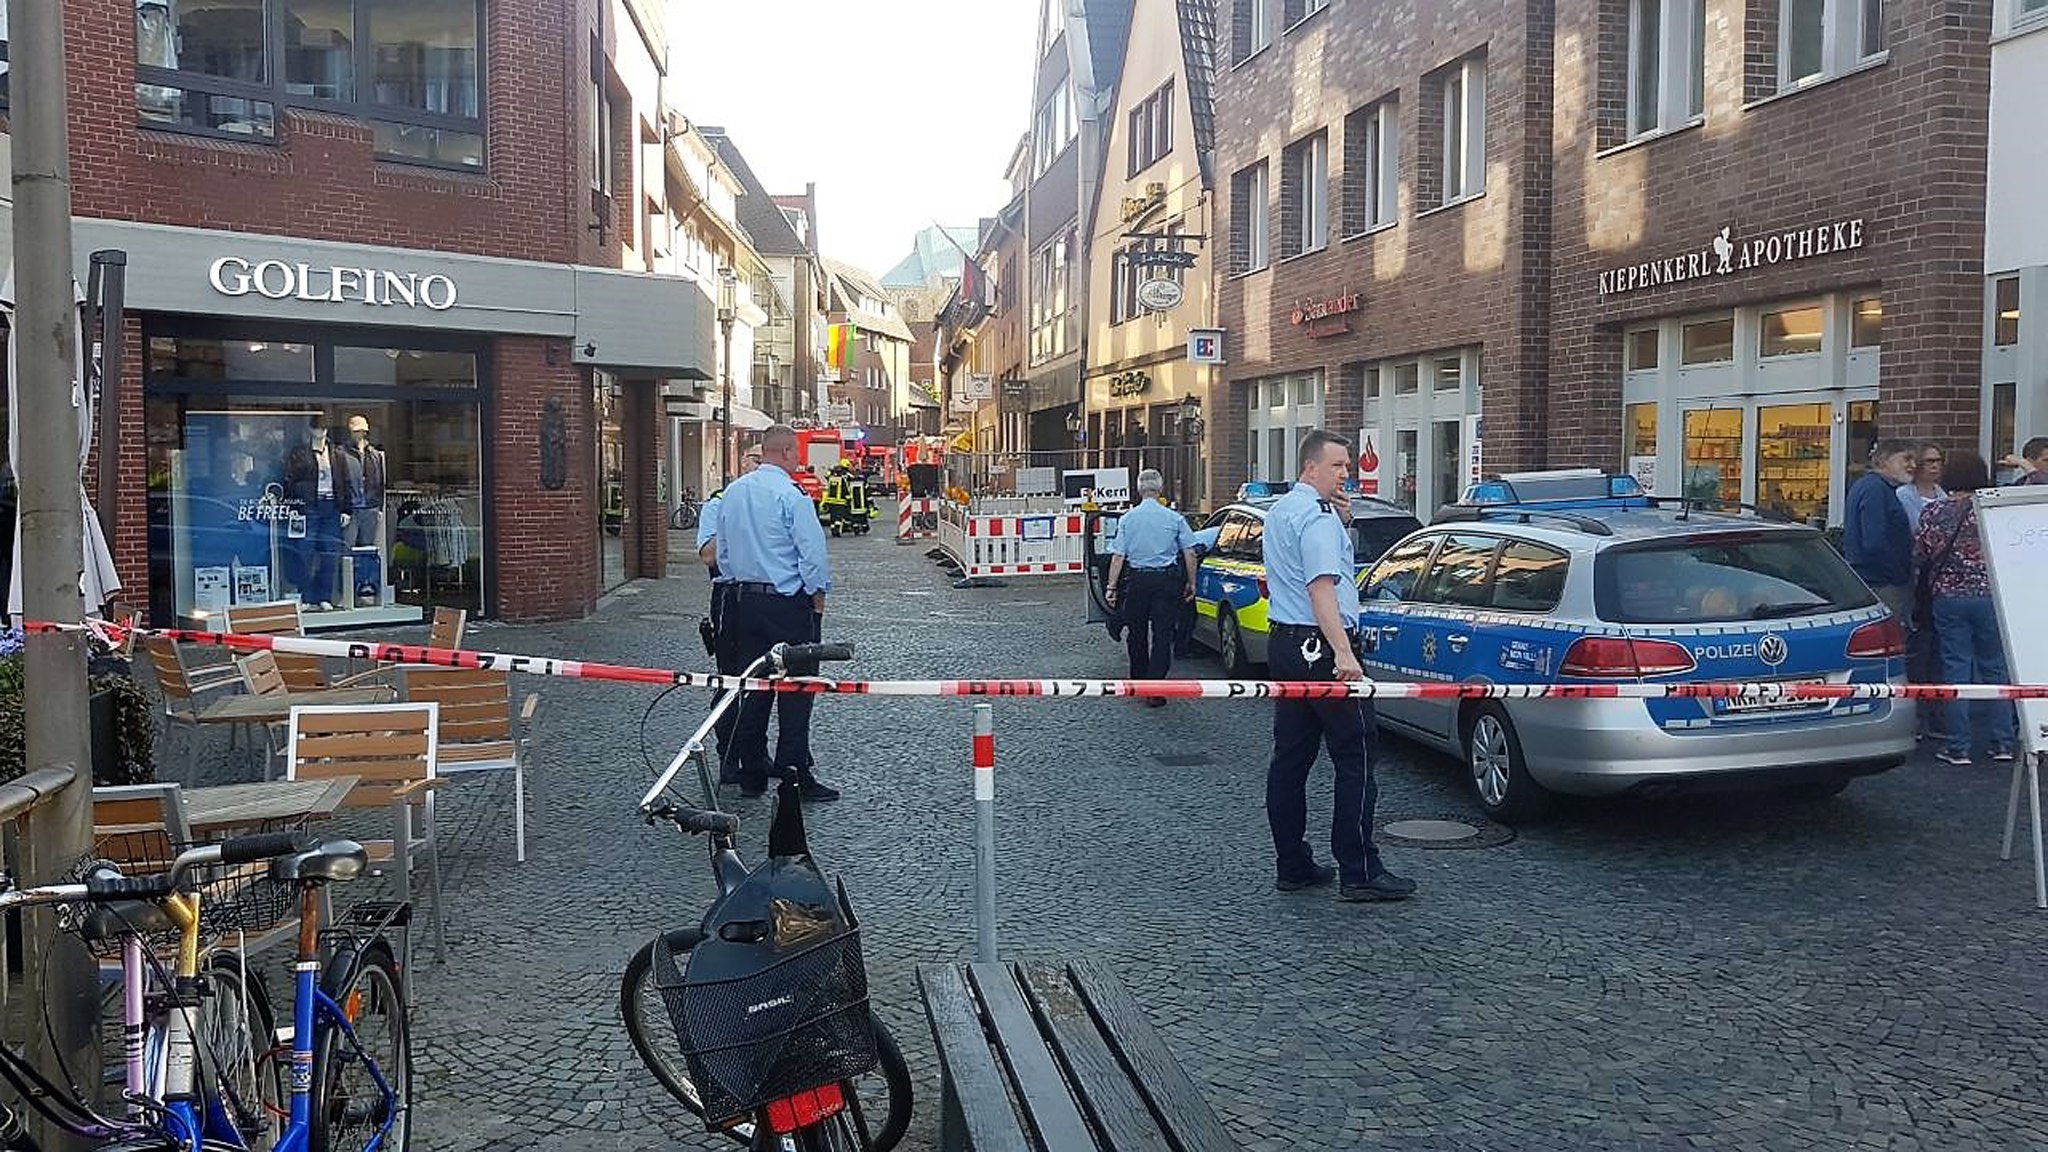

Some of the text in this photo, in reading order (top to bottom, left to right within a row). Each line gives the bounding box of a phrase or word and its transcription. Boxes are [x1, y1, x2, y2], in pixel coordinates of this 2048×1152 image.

[1599, 218, 1864, 295] KIEPENKERL APOTHEKE
[209, 256, 458, 311] GOLFINO
[238, 505, 291, 521] BE FREE!
[1695, 645, 1758, 660] POLIZEI
